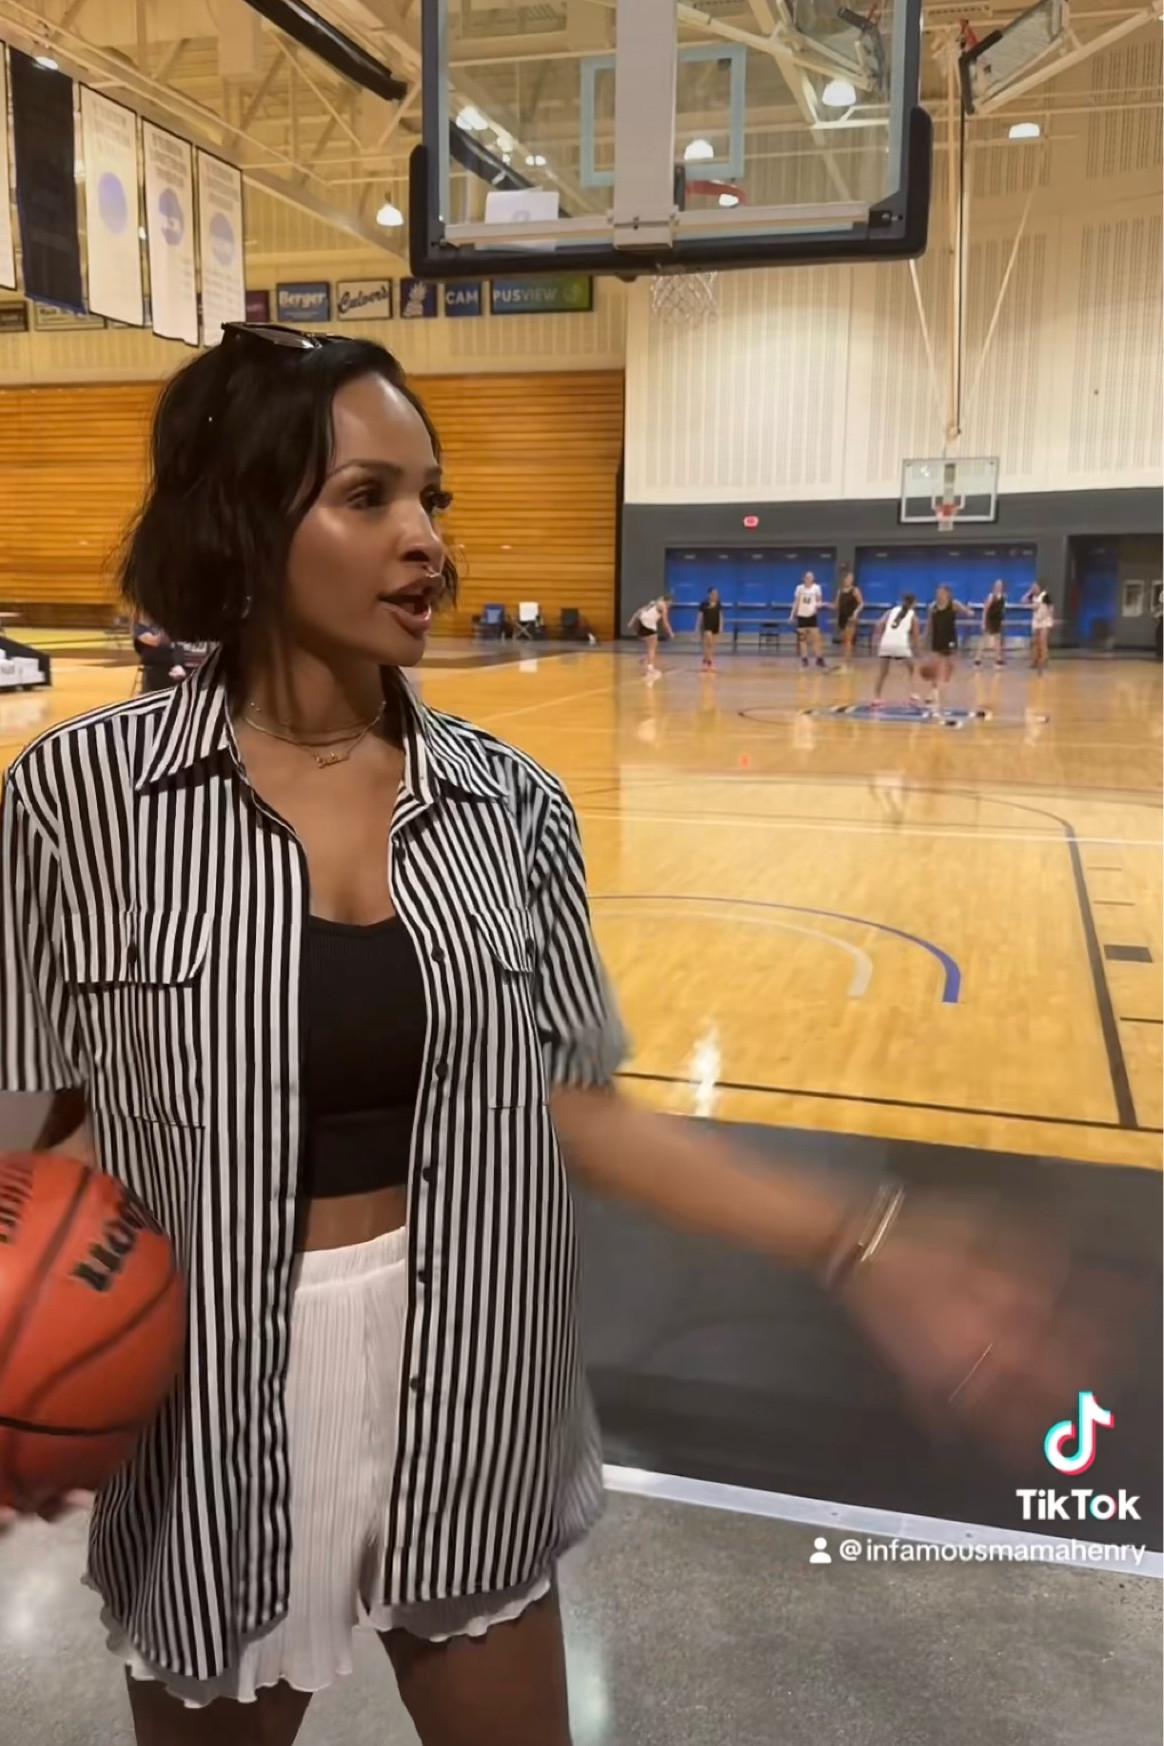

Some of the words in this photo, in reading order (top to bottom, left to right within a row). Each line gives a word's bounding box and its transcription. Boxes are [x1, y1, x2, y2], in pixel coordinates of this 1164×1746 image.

[278, 290, 327, 308] Berger
[446, 289, 479, 305] CAM
[493, 287, 557, 303] PUSVIEW
